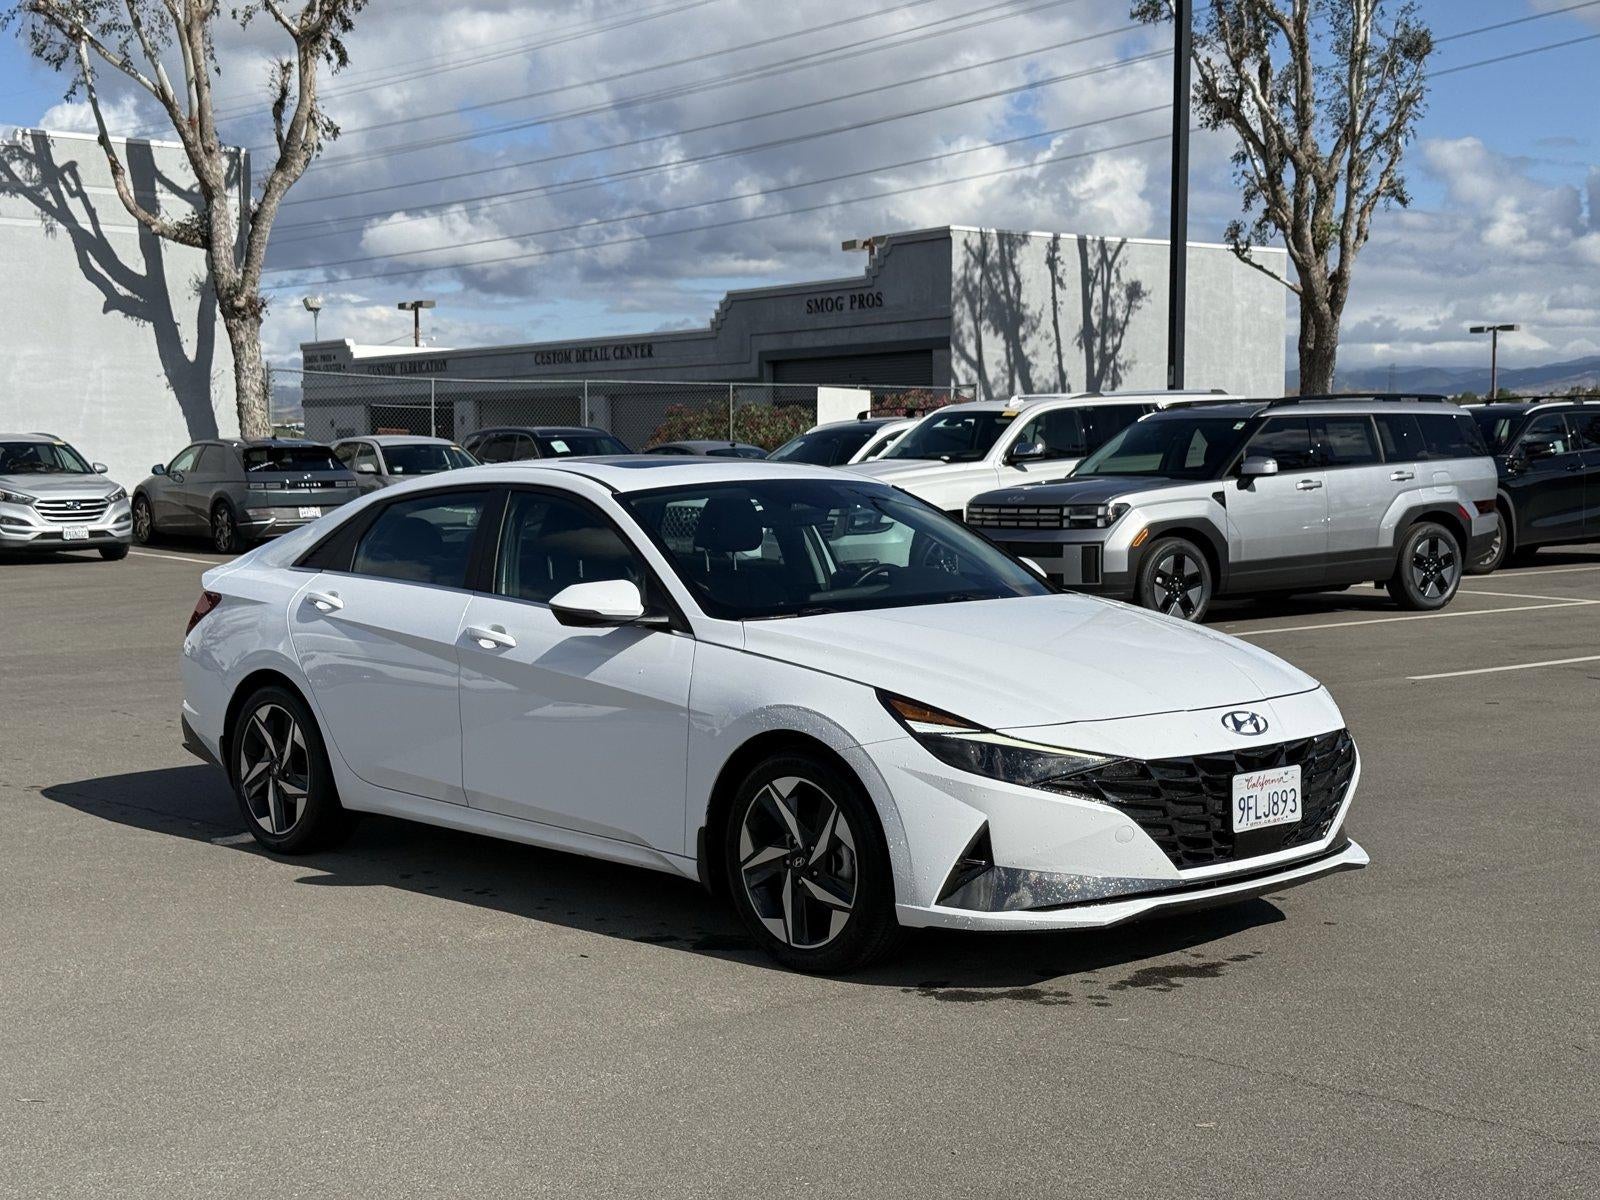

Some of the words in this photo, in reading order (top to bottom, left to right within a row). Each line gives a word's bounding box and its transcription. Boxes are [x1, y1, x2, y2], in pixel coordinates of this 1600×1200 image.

[806, 296, 844, 314] SMOG
[849, 291, 884, 310] PROS
[534, 350, 572, 365] CUSTOM
[576, 346, 611, 363] DETAIL
[613, 343, 654, 360] CENTER
[400, 359, 447, 374] FABRICATION
[1245, 774, 1289, 791] California
[1238, 788, 1297, 824] 9FLJ893
